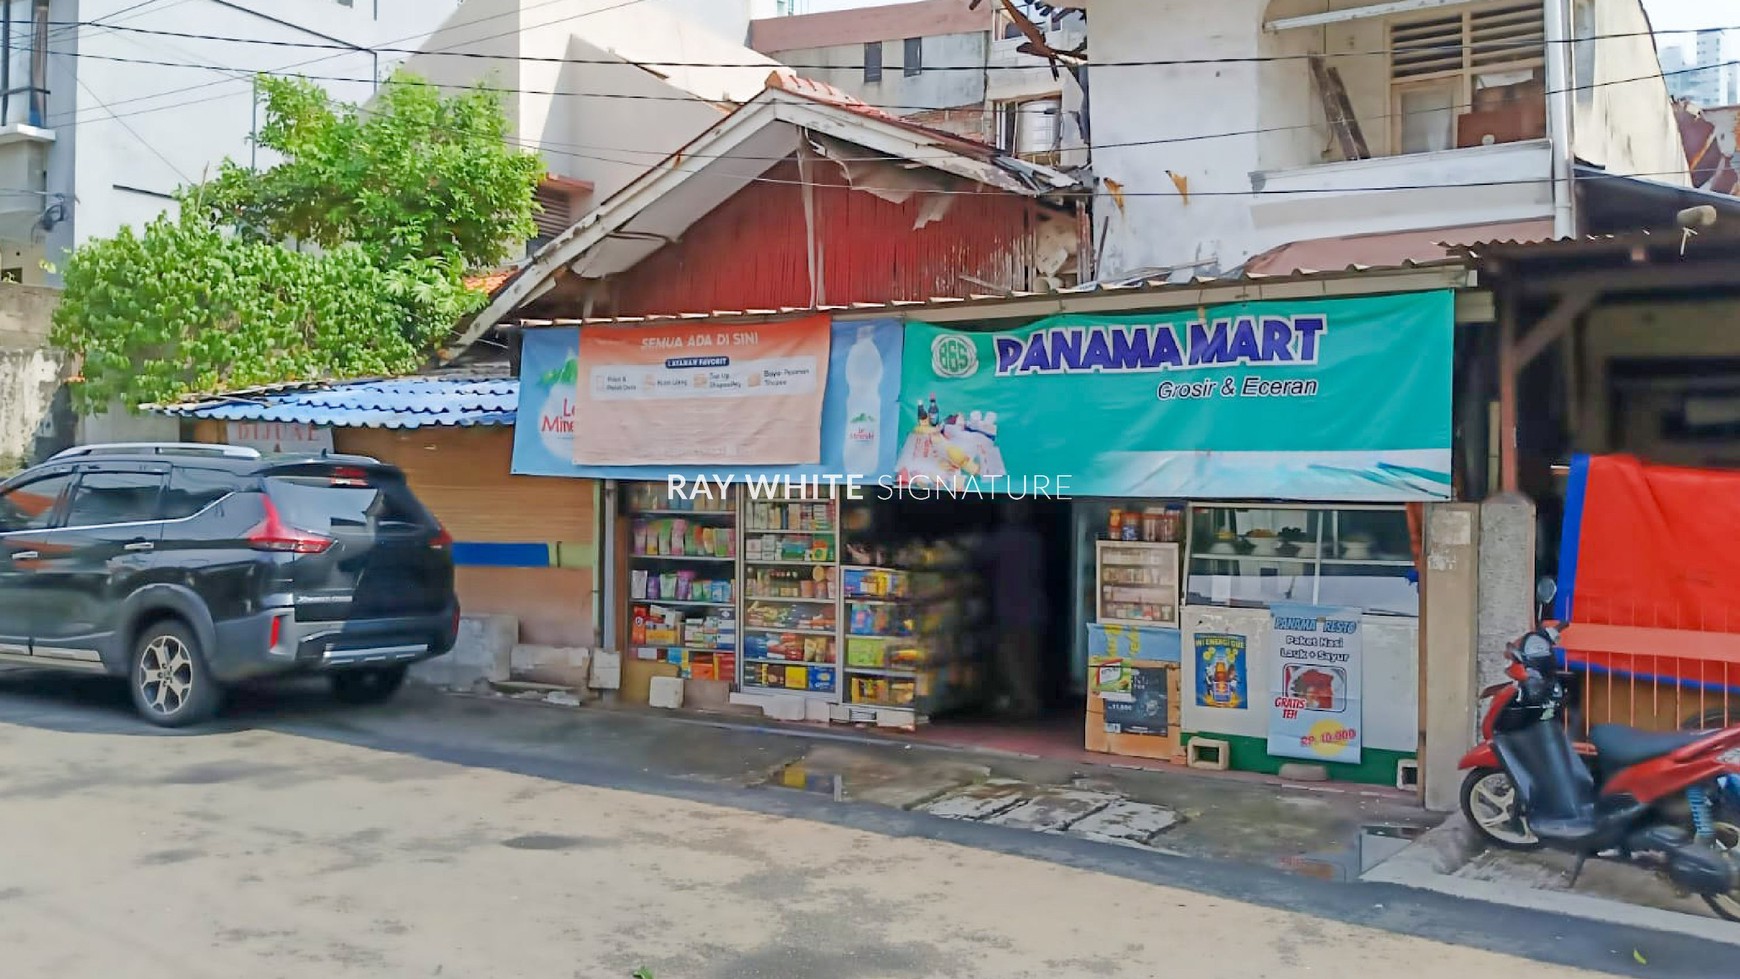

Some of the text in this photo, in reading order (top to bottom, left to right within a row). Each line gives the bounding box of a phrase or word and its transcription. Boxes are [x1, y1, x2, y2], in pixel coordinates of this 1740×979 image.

[641, 331, 758, 349] SEMUA ADA DI SINI
[995, 314, 1326, 375] PANAMA MART
[699, 357, 727, 366] FAVORIT
[1158, 376, 1317, 399] Grosir & Eceran
[1274, 617, 1357, 634] PANAMA RESTO
[1285, 635, 1344, 648] Paket Nasi
[1280, 648, 1308, 659] Lauk
[1317, 650, 1350, 662] Sayur
[1275, 697, 1306, 709] GRATIS
[1282, 709, 1298, 719] TEH
